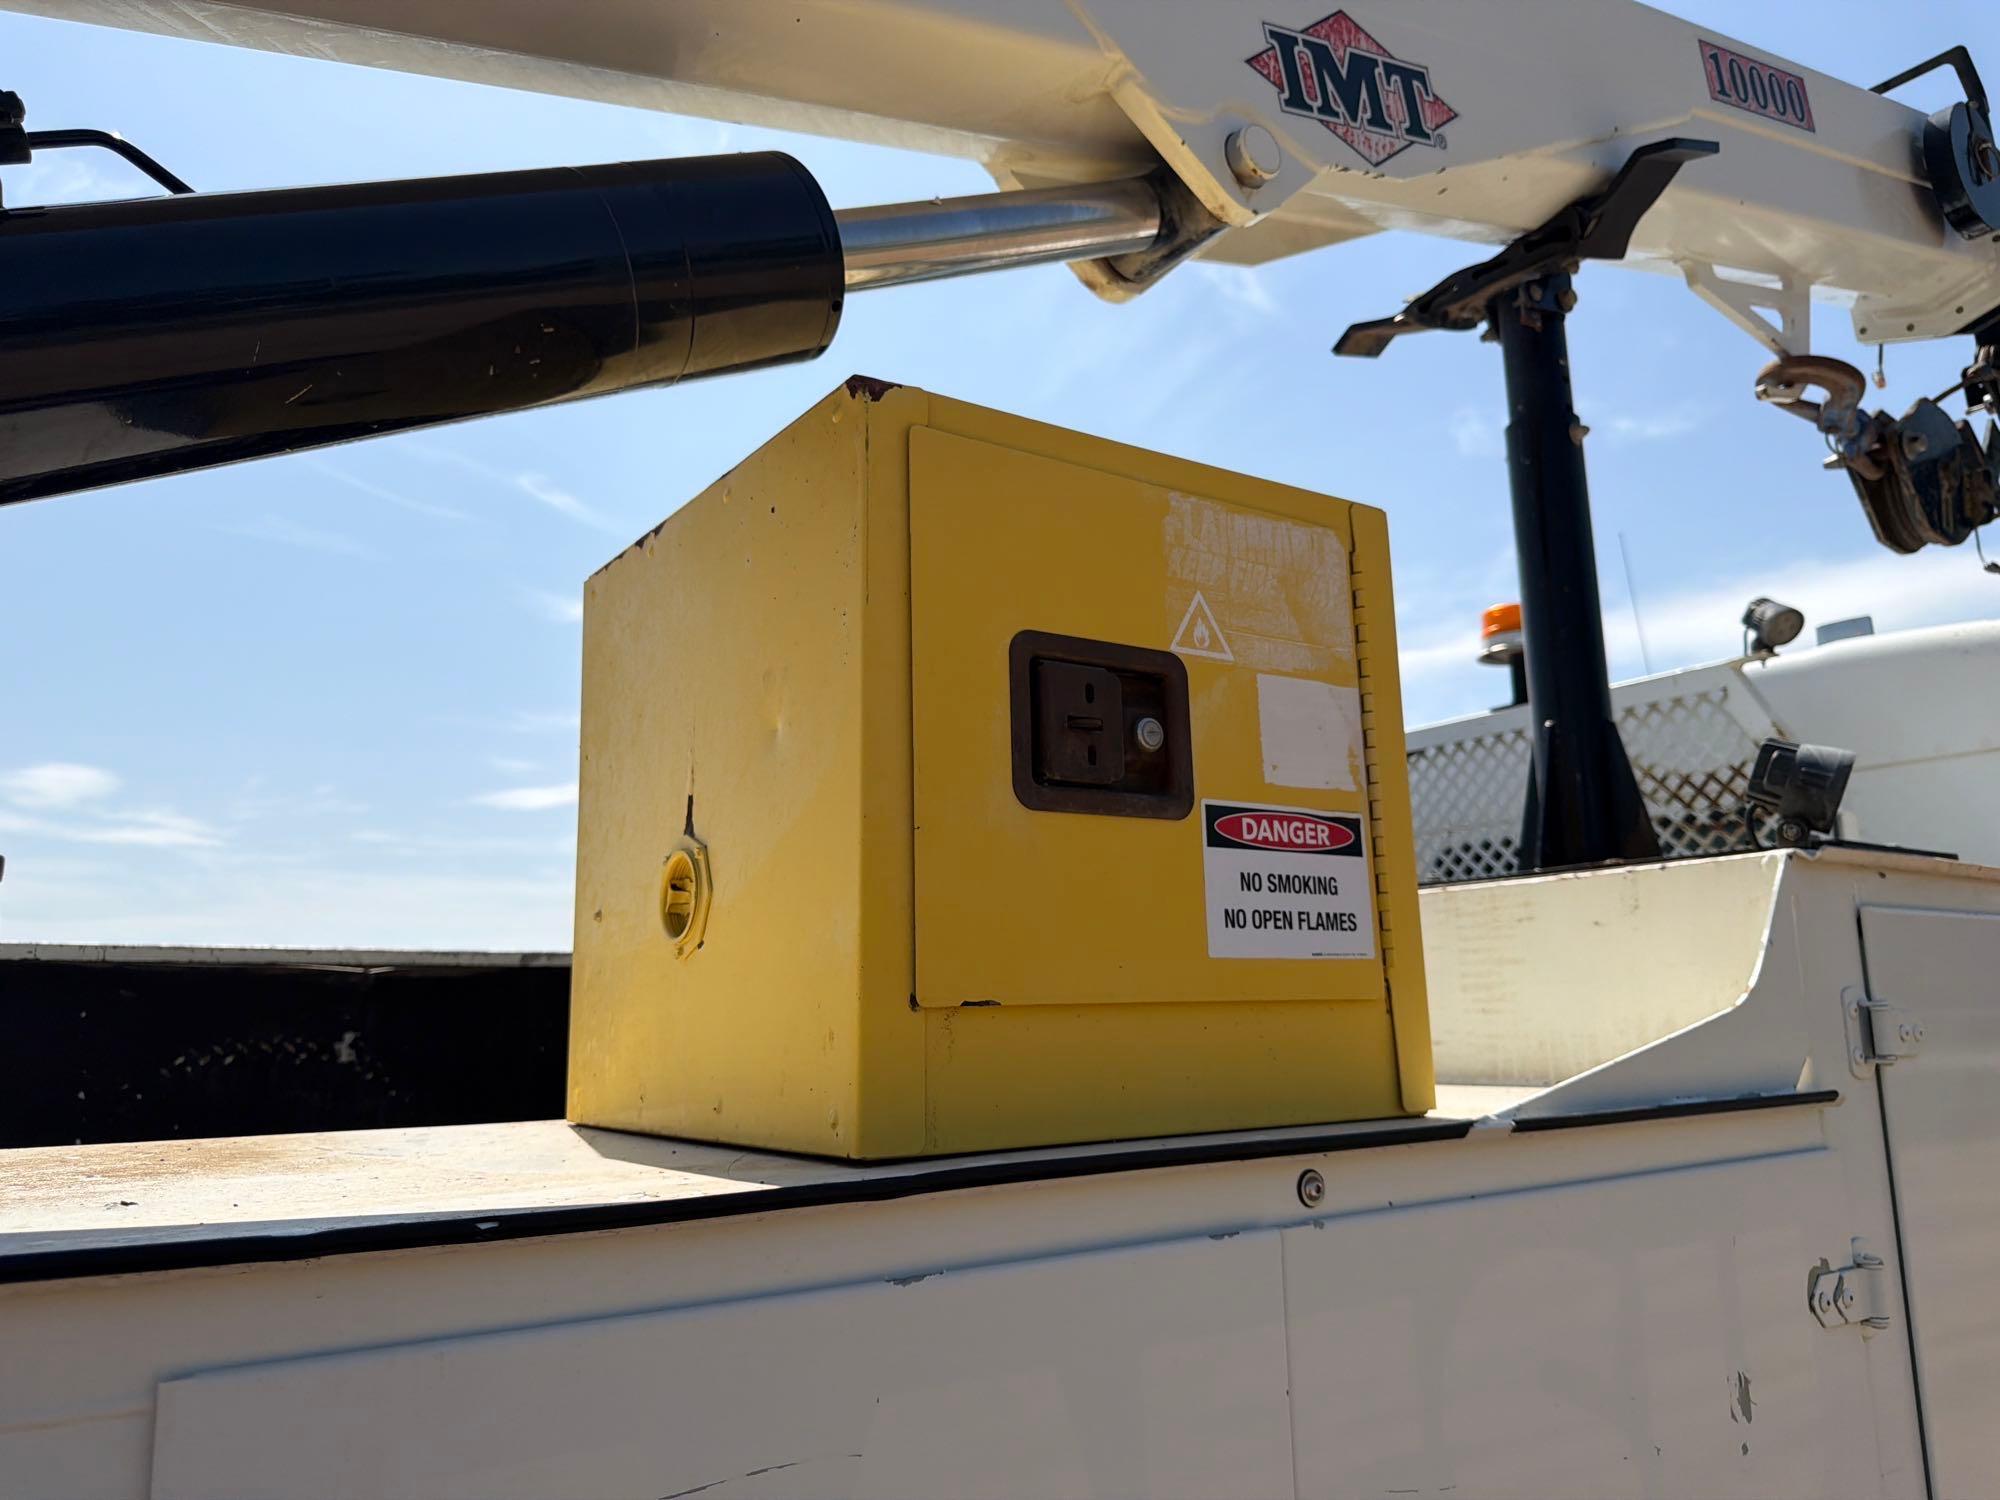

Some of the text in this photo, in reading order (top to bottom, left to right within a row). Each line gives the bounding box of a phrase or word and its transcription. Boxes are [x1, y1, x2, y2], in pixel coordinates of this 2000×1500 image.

[1709, 52, 1805, 122] 10000
[1241, 817, 1331, 846] DANGER
[1240, 872, 1339, 896] NO SMOKING
[1224, 908, 1358, 932] NO OPEN FLAMES
